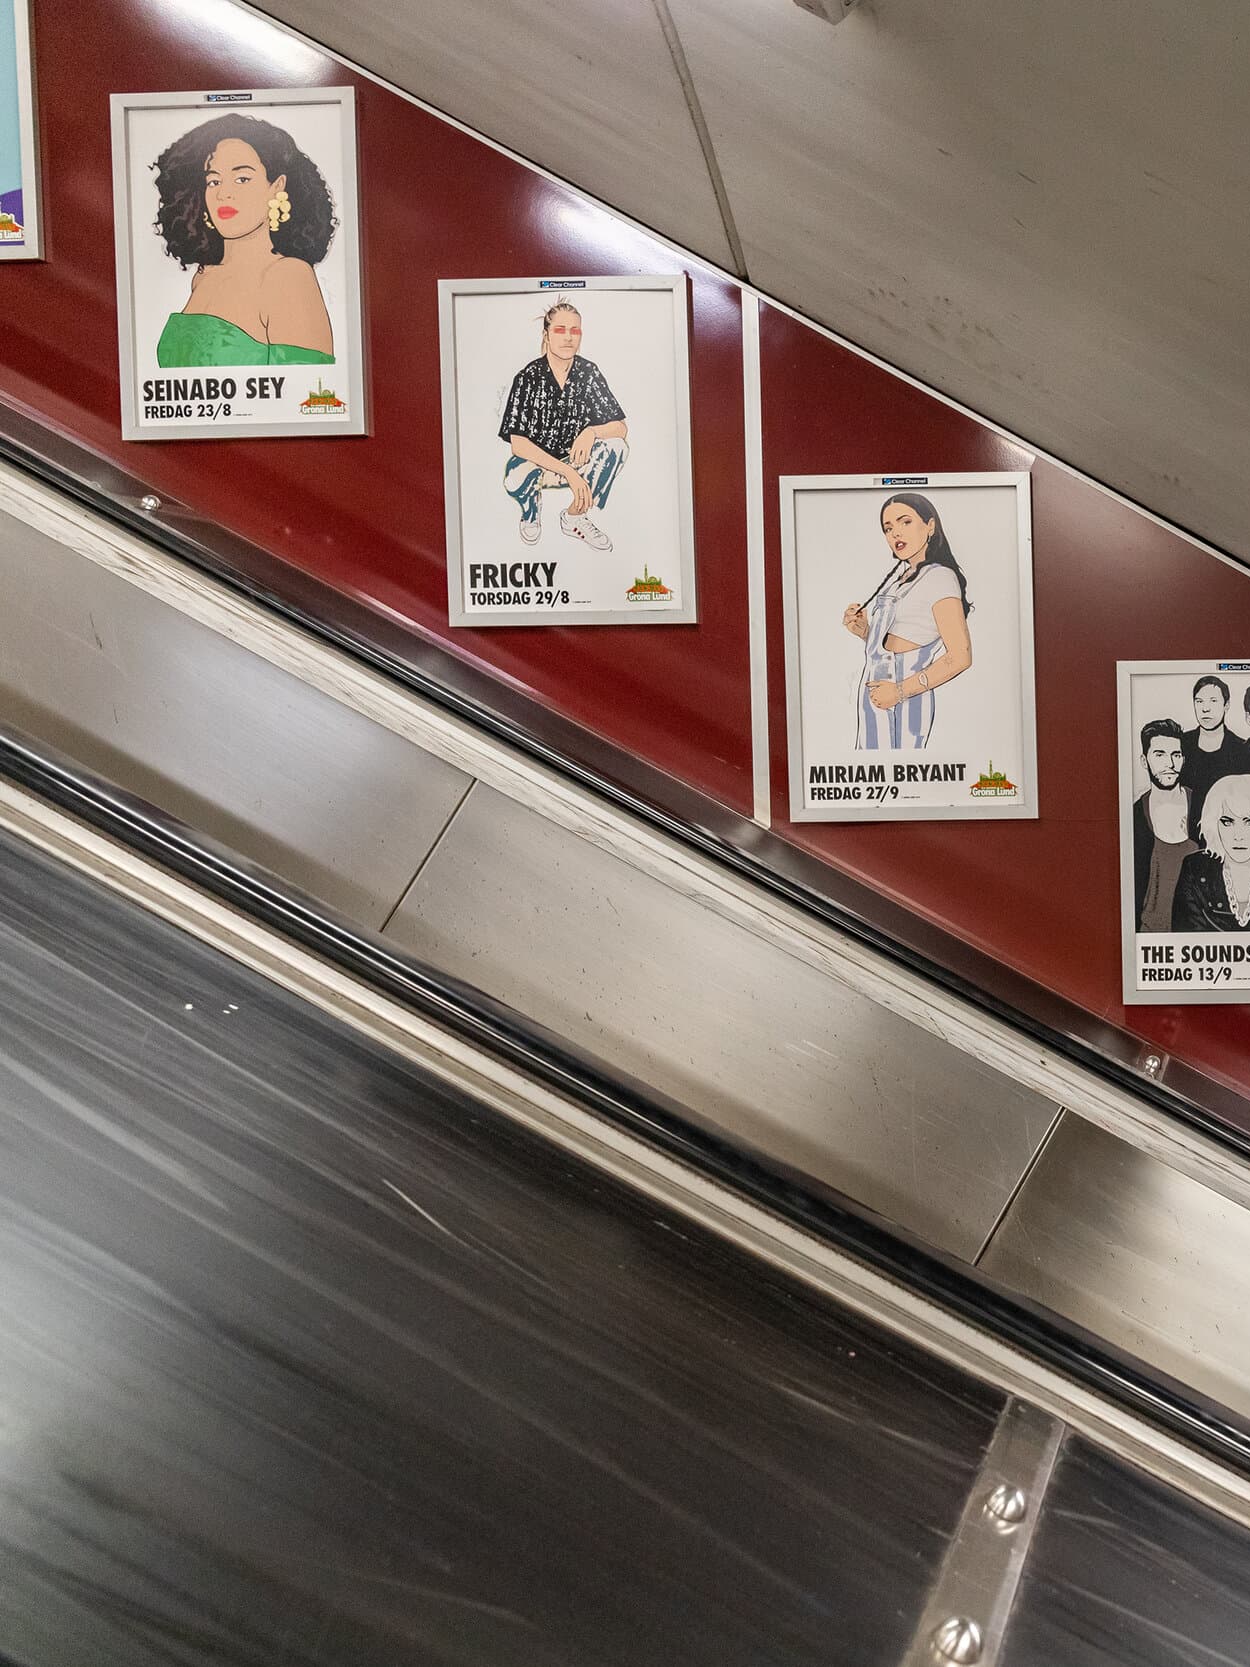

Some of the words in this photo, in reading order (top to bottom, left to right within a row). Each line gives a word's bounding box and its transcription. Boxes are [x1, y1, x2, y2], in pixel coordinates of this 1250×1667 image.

[143, 378, 236, 402] SEINABO
[246, 377, 284, 399] SEY
[145, 405, 192, 418] FREDAG
[198, 403, 231, 420] 23/8
[470, 562, 556, 588] FRICKY
[470, 592, 530, 605] TORSDAG
[536, 590, 569, 607] 29/8
[810, 765, 885, 783] MIRIAM
[894, 764, 966, 782] BRYANT
[811, 787, 861, 800] FREDAG
[866, 785, 898, 802] 27/9
[1141, 946, 1174, 963] THE
[1142, 968, 1192, 981] FREDAG
[1199, 967, 1231, 984] 13/9
